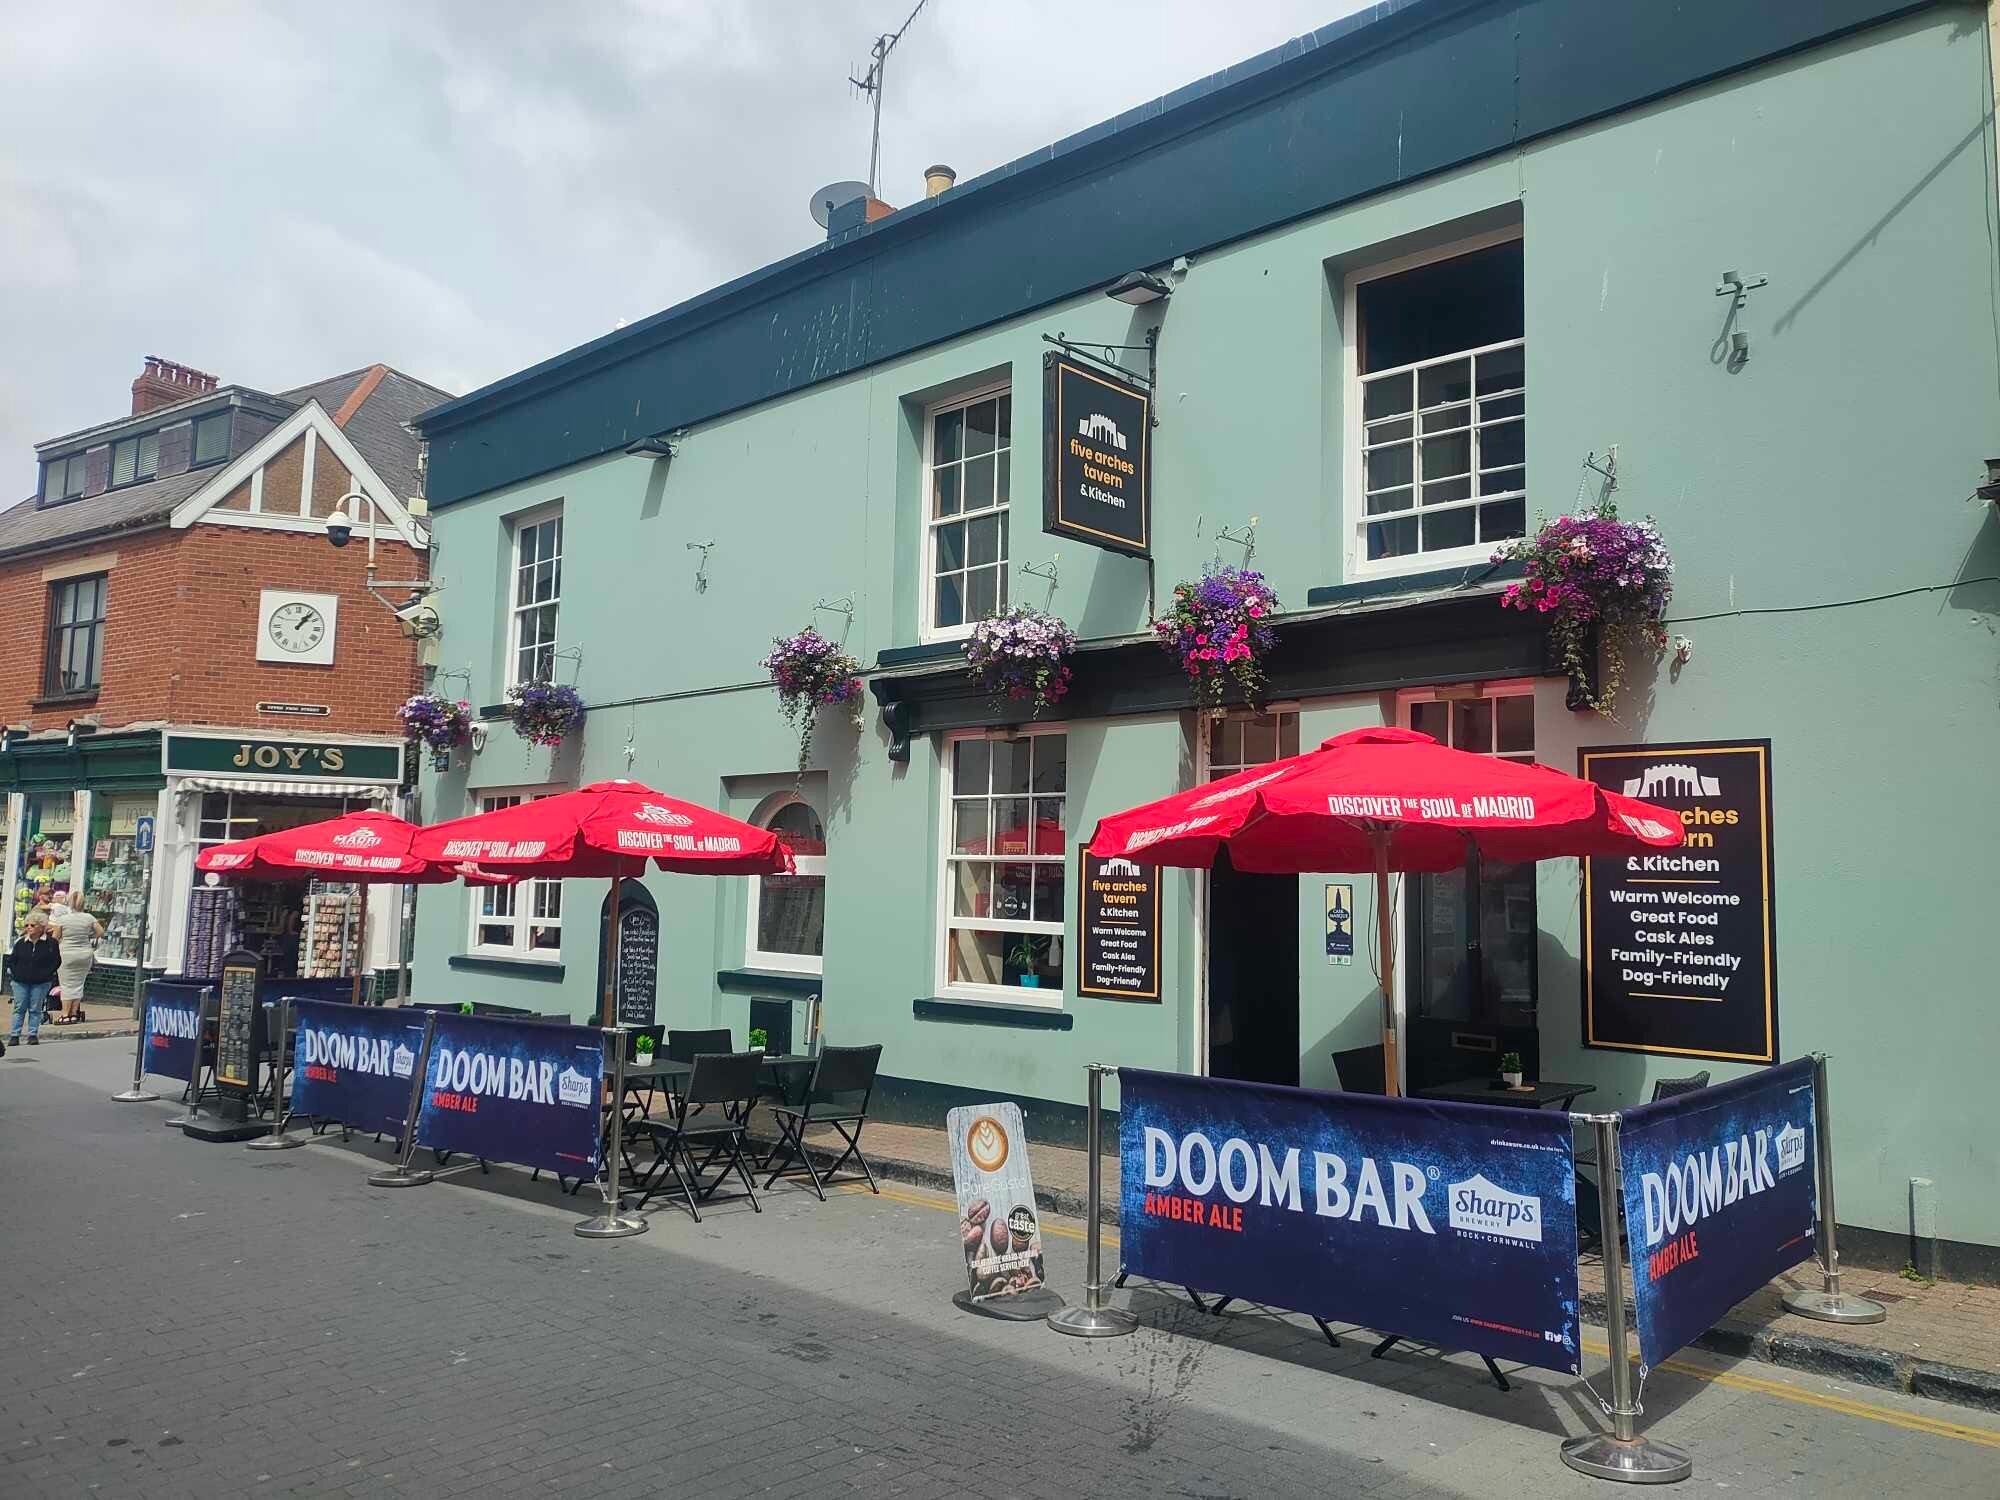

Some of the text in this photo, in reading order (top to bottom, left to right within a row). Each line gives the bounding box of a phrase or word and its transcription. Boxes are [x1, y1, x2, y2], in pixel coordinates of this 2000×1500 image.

[1070, 438, 1134, 475] five arches
[1084, 462, 1123, 488] tavern
[1080, 484, 1126, 508] & Kitchen
[232, 744, 344, 771] JOY'S
[1328, 796, 1535, 820] DISCOVER THE SOUL OF MADRID
[1680, 806, 1739, 825] ches
[442, 840, 482, 857] DISCOVER
[489, 841, 509, 858] SOUL
[514, 841, 546, 858] MADRID
[618, 830, 740, 852] DISCOVER THE SOUL OF MADRID
[295, 850, 334, 865] DISCOVER
[344, 854, 362, 867] SOUL
[370, 857, 402, 868] MADRID
[1627, 855, 1720, 872] & Kitchen
[1092, 880, 1148, 892] five arches
[1103, 894, 1136, 904] tavern
[1610, 890, 1740, 906] Warm Welcome
[1100, 908, 1139, 918] & Kitchen
[1630, 910, 1718, 926] Great Food
[1092, 926, 1147, 937] Warm Welcome
[1634, 930, 1714, 946] Cask Ales
[1100, 940, 1138, 948] Great Food
[1102, 952, 1136, 960] Cask Ales
[1611, 949, 1741, 970] Family-Friendly
[1092, 963, 1146, 976] Family-Friendly
[1622, 968, 1730, 990] Dog-Friendly
[1096, 976, 1142, 988] Dog-Friendly
[152, 1006, 196, 1040] DOOM BAR
[305, 1029, 390, 1076] DOOM BAR
[435, 1048, 506, 1098] DOOM
[562, 1077, 589, 1096] Sharp's
[432, 1092, 478, 1113] AMBER ALE
[1144, 1126, 1303, 1212] DOOM
[1641, 1145, 1722, 1246] DOOM
[1144, 1192, 1243, 1232] AMBER ALE
[1455, 1187, 1534, 1227] Sharp's
[1009, 1218, 1034, 1233] taste
[1460, 1216, 1500, 1228] BREWERY
[1456, 1230, 1536, 1250] ROCK CORNWALL
[1650, 1231, 1698, 1281] AMBER ALE
